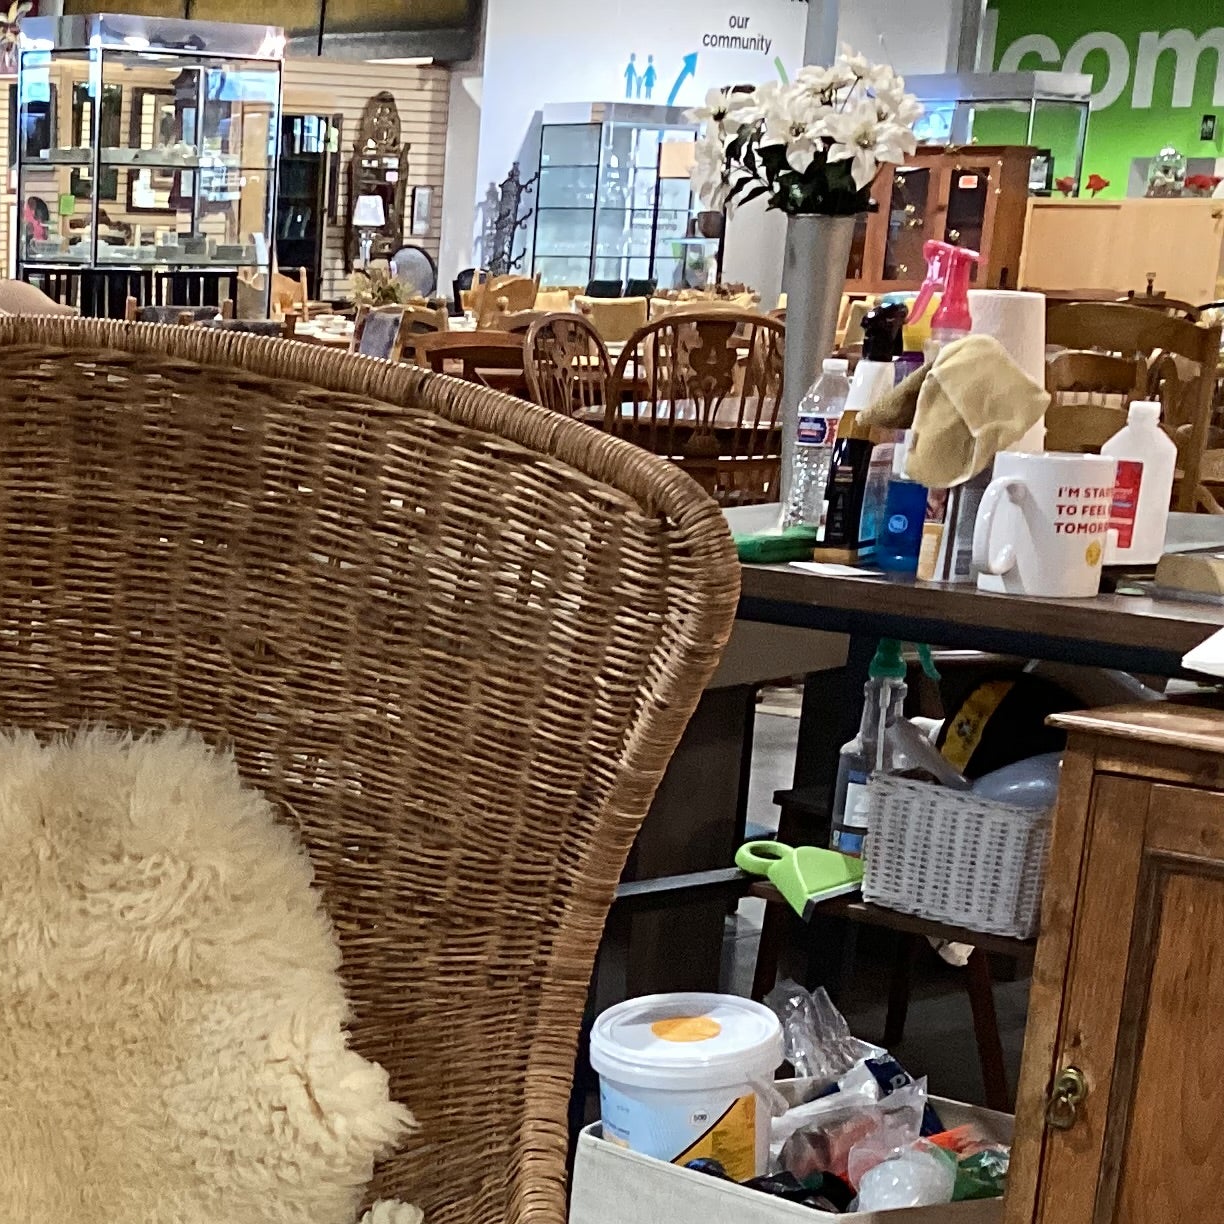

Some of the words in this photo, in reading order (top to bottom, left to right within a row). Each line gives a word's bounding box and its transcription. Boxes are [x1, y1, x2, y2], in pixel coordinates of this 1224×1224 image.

[728, 15, 750, 29] our
[702, 33, 772, 55] community
[1058, 487, 1080, 498] I'M
[1056, 505, 1077, 516] TO
